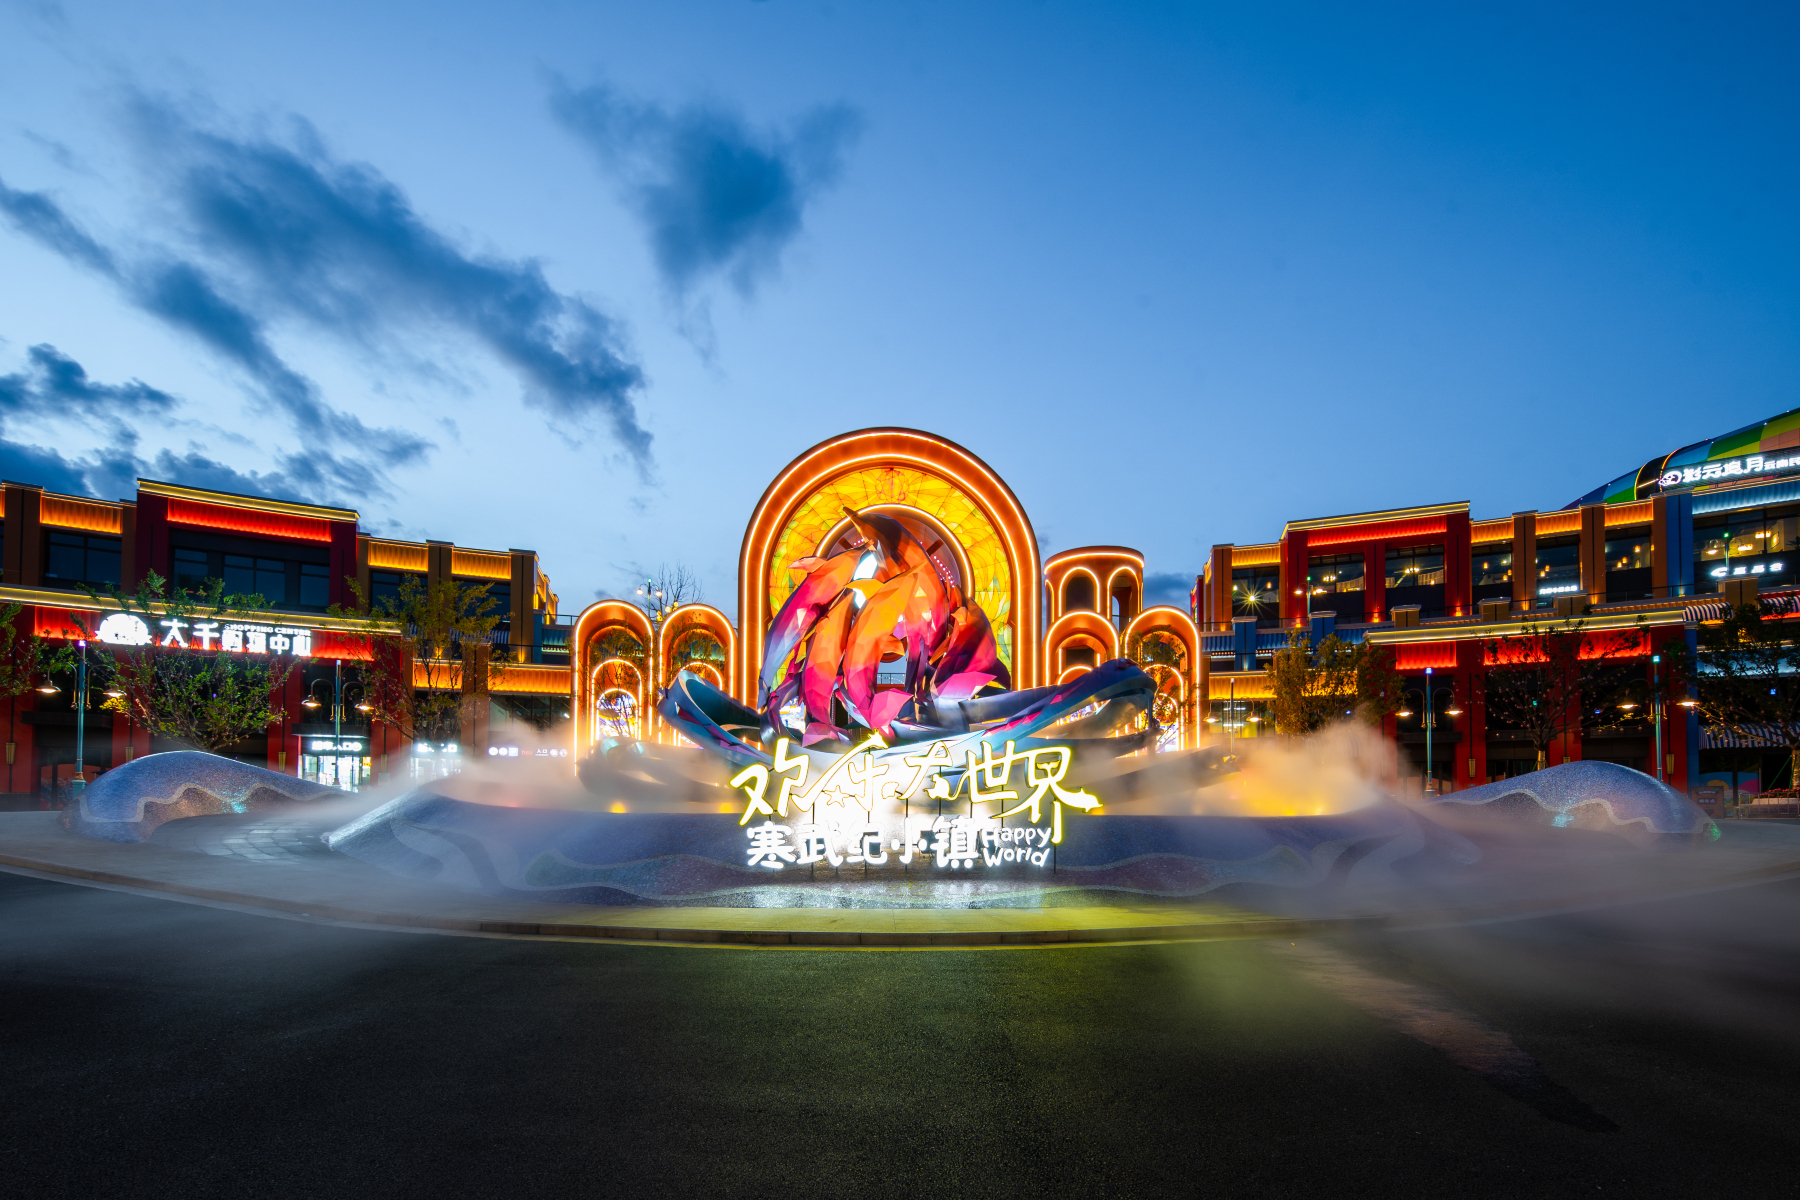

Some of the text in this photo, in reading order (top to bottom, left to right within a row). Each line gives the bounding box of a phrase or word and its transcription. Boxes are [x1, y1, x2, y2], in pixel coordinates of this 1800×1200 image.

[224, 623, 312, 637] SHOPPING CENTER
[729, 730, 1104, 844] 欢乐大世界
[746, 815, 979, 870] 寒武纪小镇
[982, 823, 1052, 849] Happy
[983, 846, 1051, 868] World
